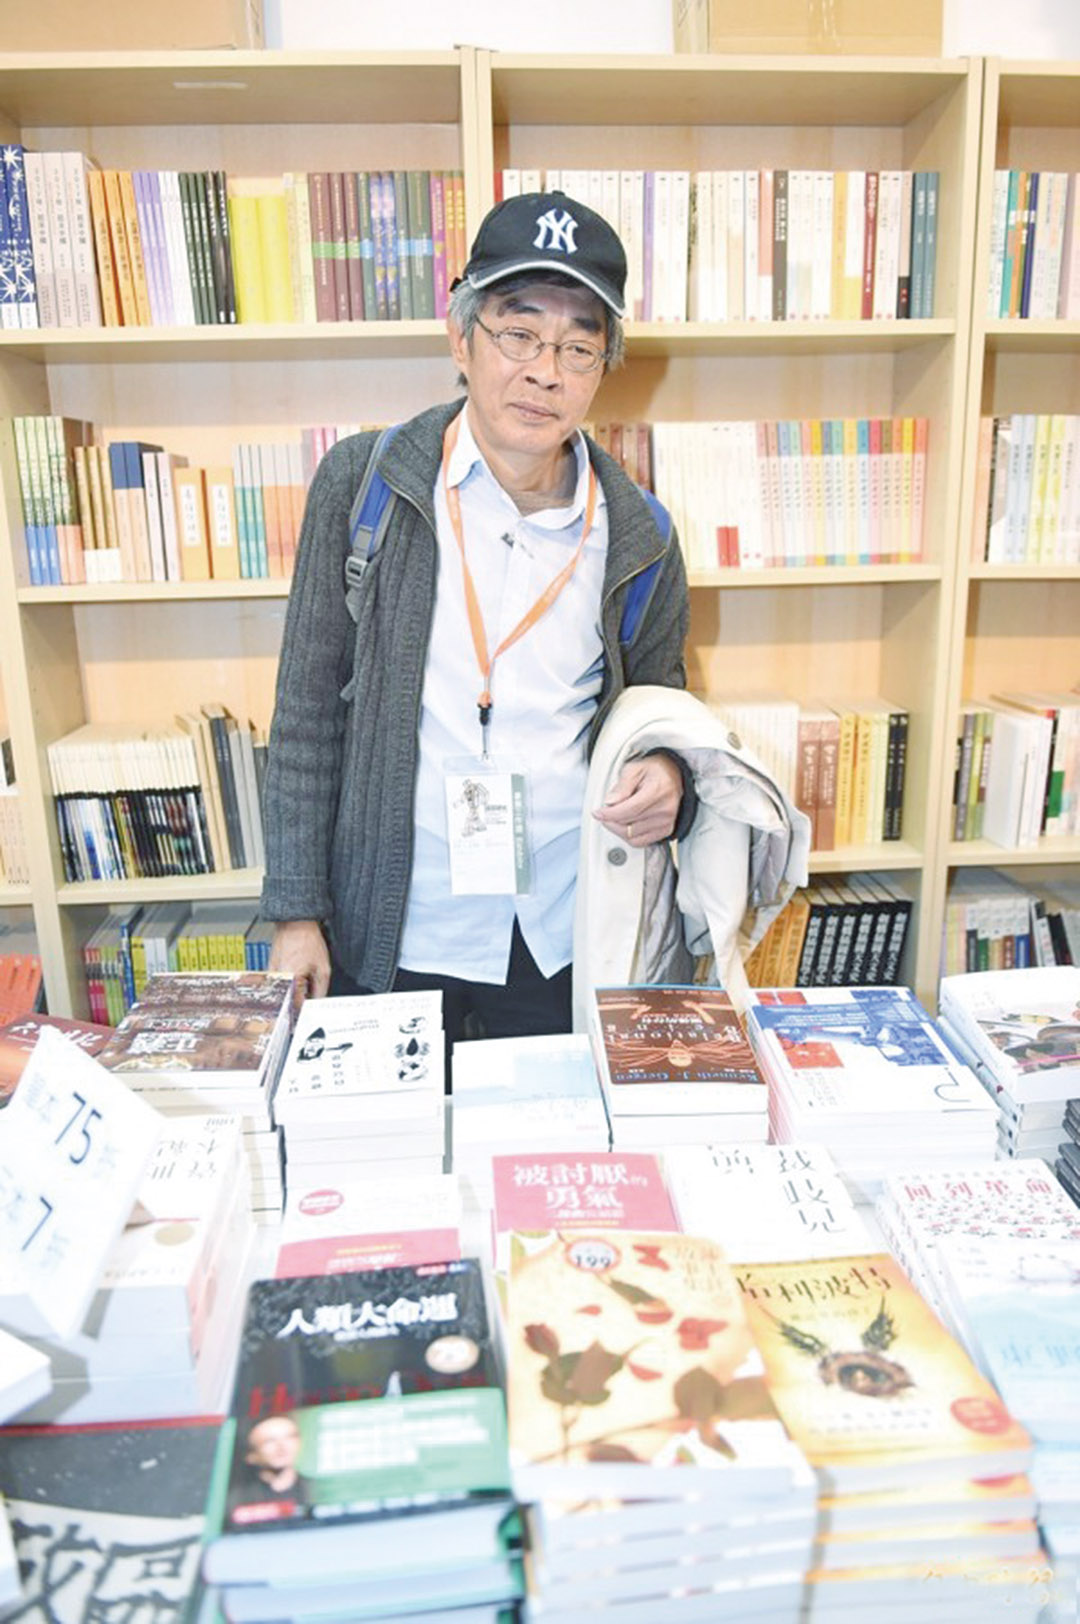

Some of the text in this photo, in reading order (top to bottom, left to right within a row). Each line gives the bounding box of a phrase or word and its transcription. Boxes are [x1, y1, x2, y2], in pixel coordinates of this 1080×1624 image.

[533, 208, 578, 254] NY
[55, 1091, 102, 1165] 75
[512, 1161, 648, 1187] 被討厭的
[545, 1185, 624, 1210] 勇氣
[574, 1253, 611, 1269] 199
[276, 1292, 459, 1339] 人類大命運
